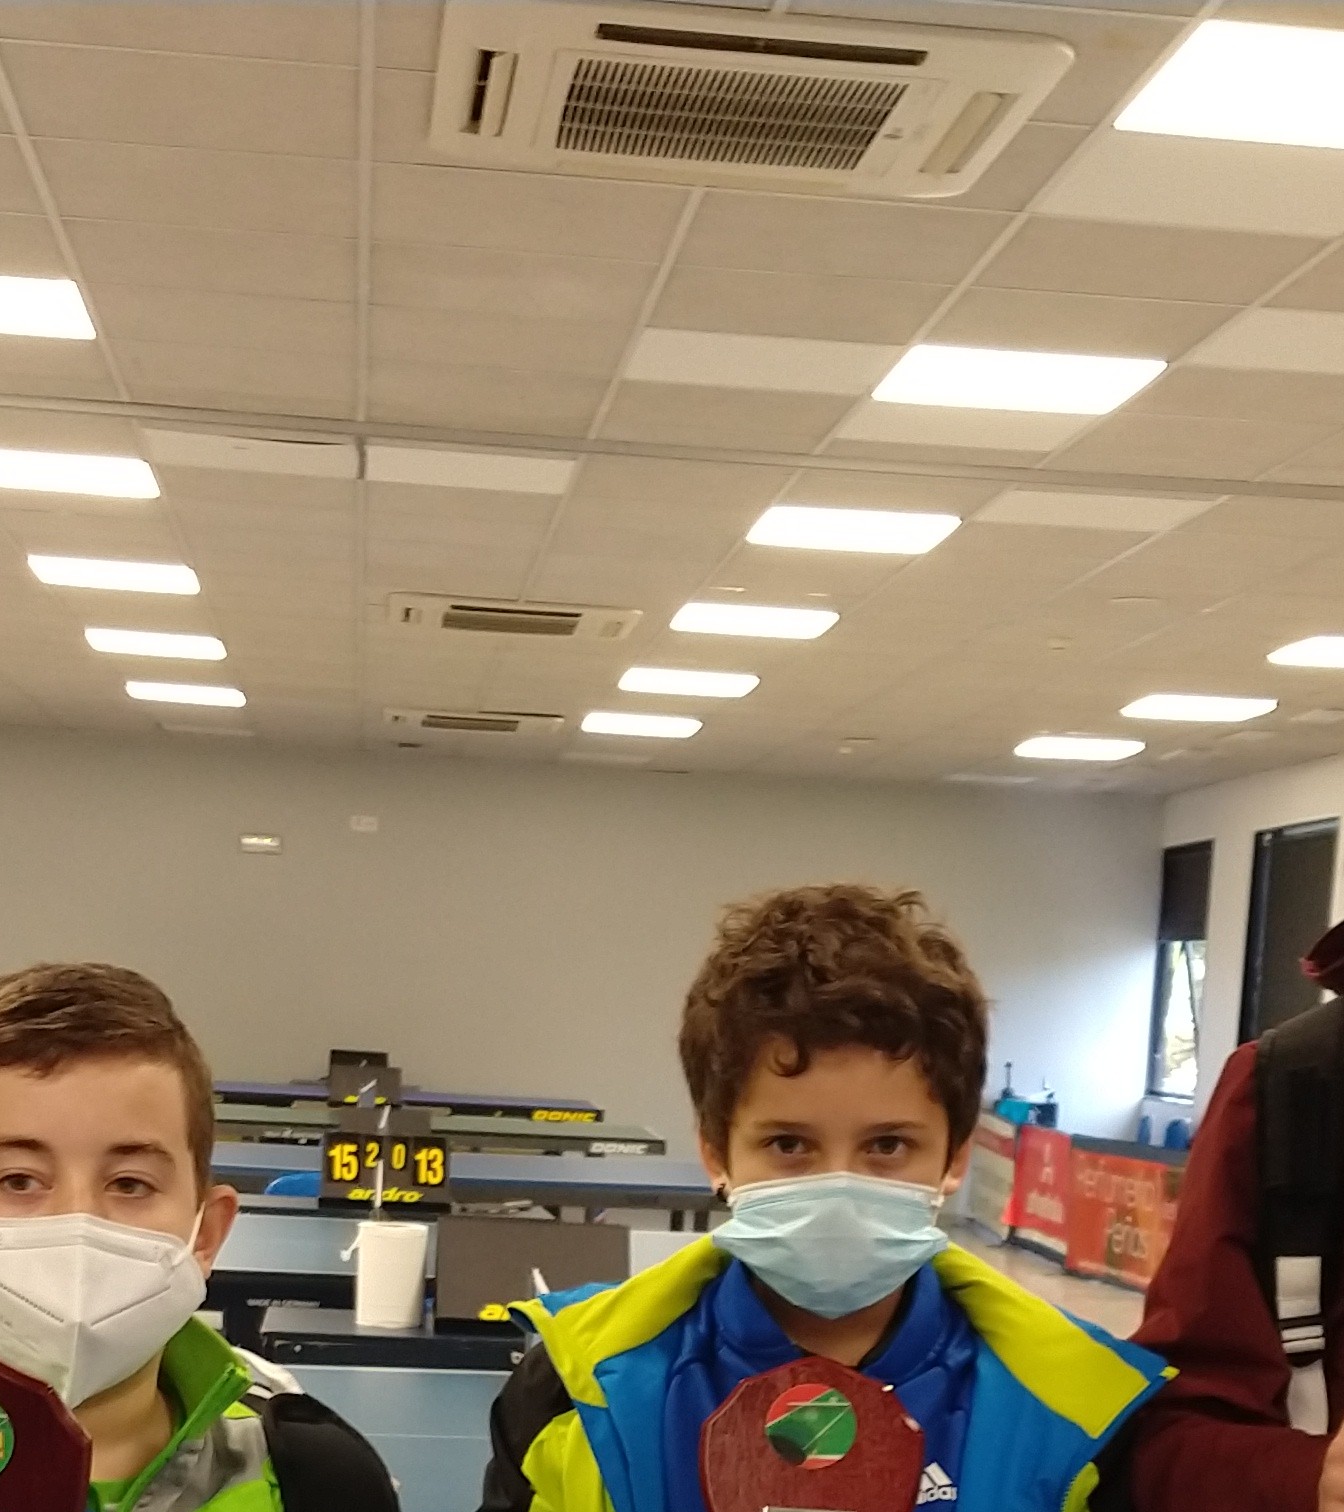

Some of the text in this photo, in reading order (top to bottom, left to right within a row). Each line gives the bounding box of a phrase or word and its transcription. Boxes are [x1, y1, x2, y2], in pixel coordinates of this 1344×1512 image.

[327, 1143, 359, 1181] 15
[364, 1142, 380, 1168] 2
[391, 1143, 406, 1170] 0
[414, 1147, 444, 1185] 13
